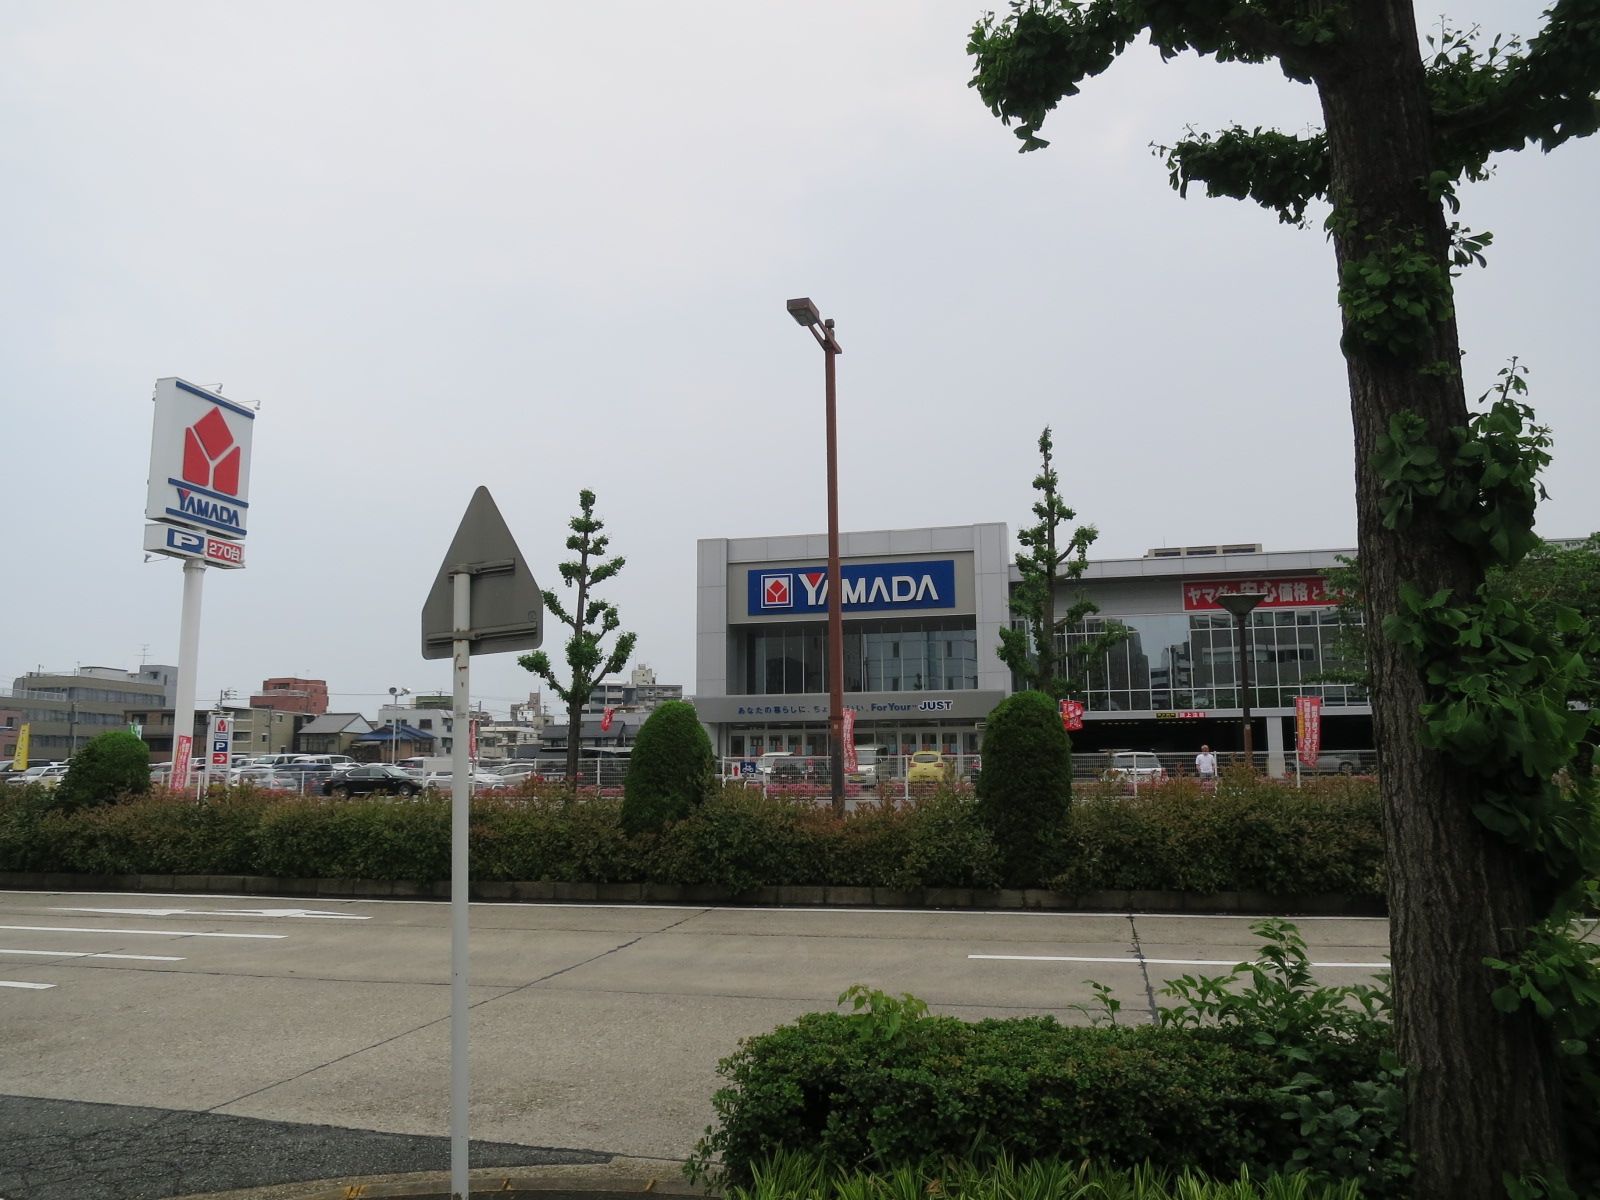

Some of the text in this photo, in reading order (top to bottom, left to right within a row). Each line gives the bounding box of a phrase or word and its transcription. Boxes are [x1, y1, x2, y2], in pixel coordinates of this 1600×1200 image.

[176, 487, 240, 528] YAMADA
[173, 532, 241, 562] P 270台
[919, 699, 953, 711] JUST
[215, 742, 226, 751] P
